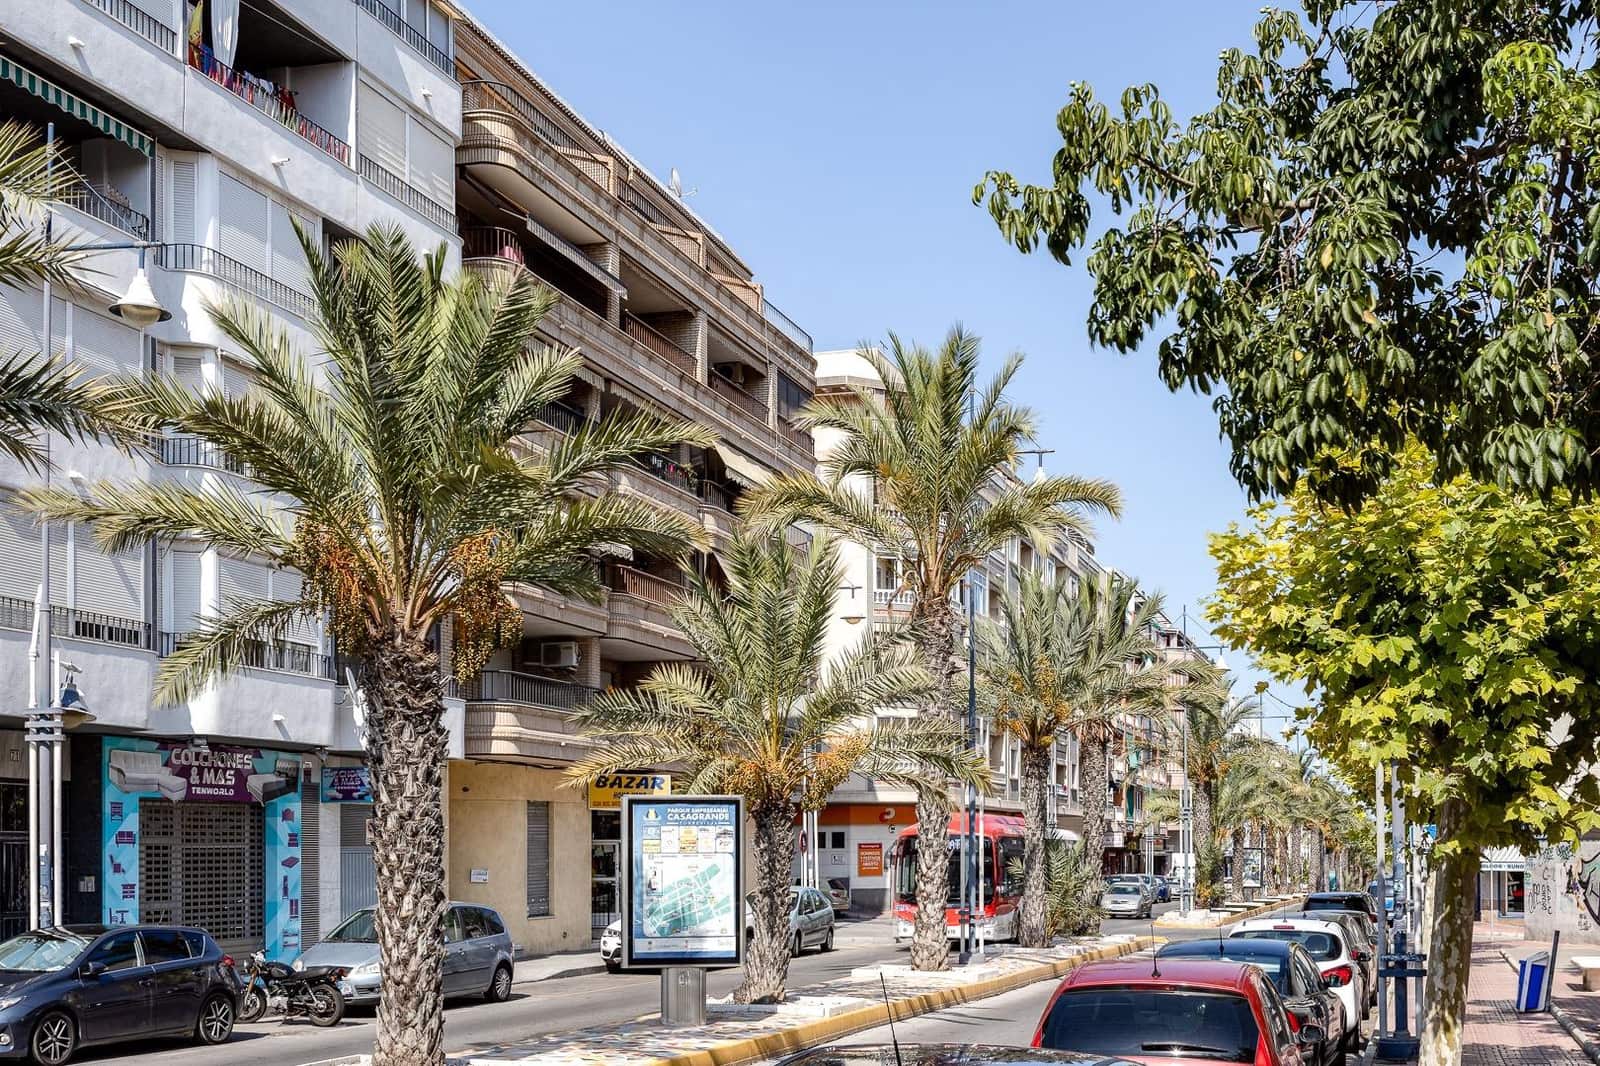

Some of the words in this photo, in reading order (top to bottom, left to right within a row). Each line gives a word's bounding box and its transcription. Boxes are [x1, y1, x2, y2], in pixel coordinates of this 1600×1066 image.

[171, 749, 252, 769] COLCHONES
[190, 768, 200, 785] &
[202, 770, 235, 786] MAS
[595, 775, 665, 790] BAZAR
[191, 787, 234, 796] TENWORLD
[667, 813, 729, 821] CASAGRANDE
